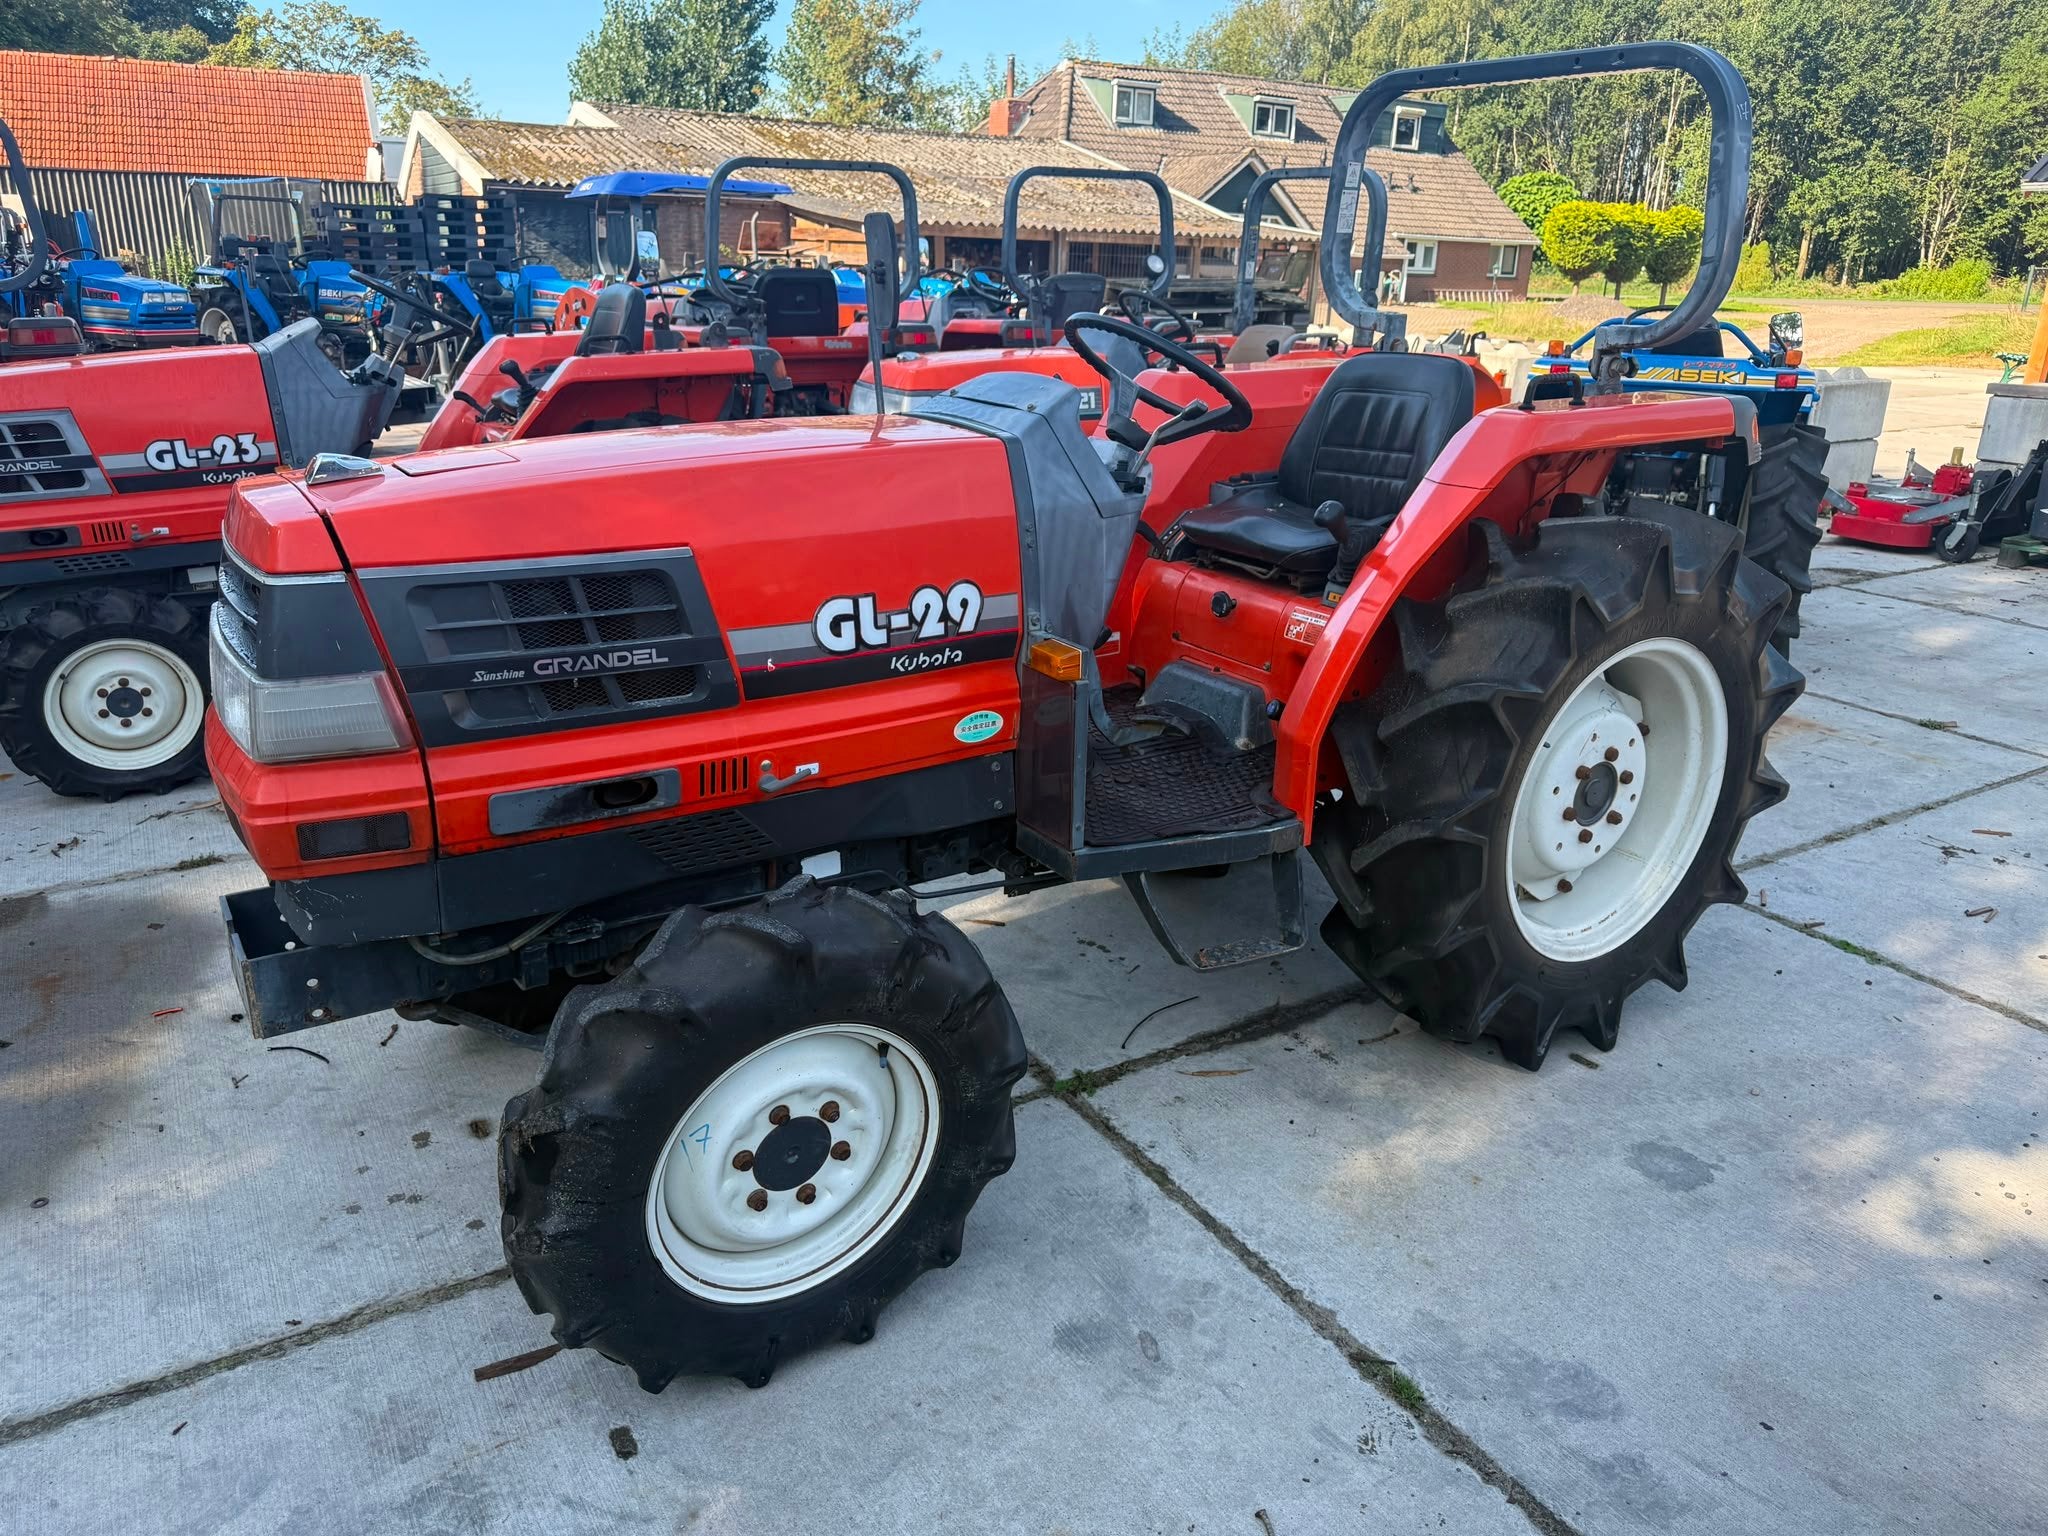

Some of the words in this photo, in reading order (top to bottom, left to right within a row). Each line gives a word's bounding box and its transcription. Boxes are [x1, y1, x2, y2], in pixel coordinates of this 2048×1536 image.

[1673, 368, 1747, 384] ISEKI
[1079, 391, 1096, 410] 21
[145, 433, 261, 471] GL-23
[814, 580, 983, 654] GL-29
[470, 669, 526, 682] Sunshine
[533, 648, 669, 676] GRANDEL
[890, 648, 963, 672] Kubota
[681, 1123, 713, 1173] 17
